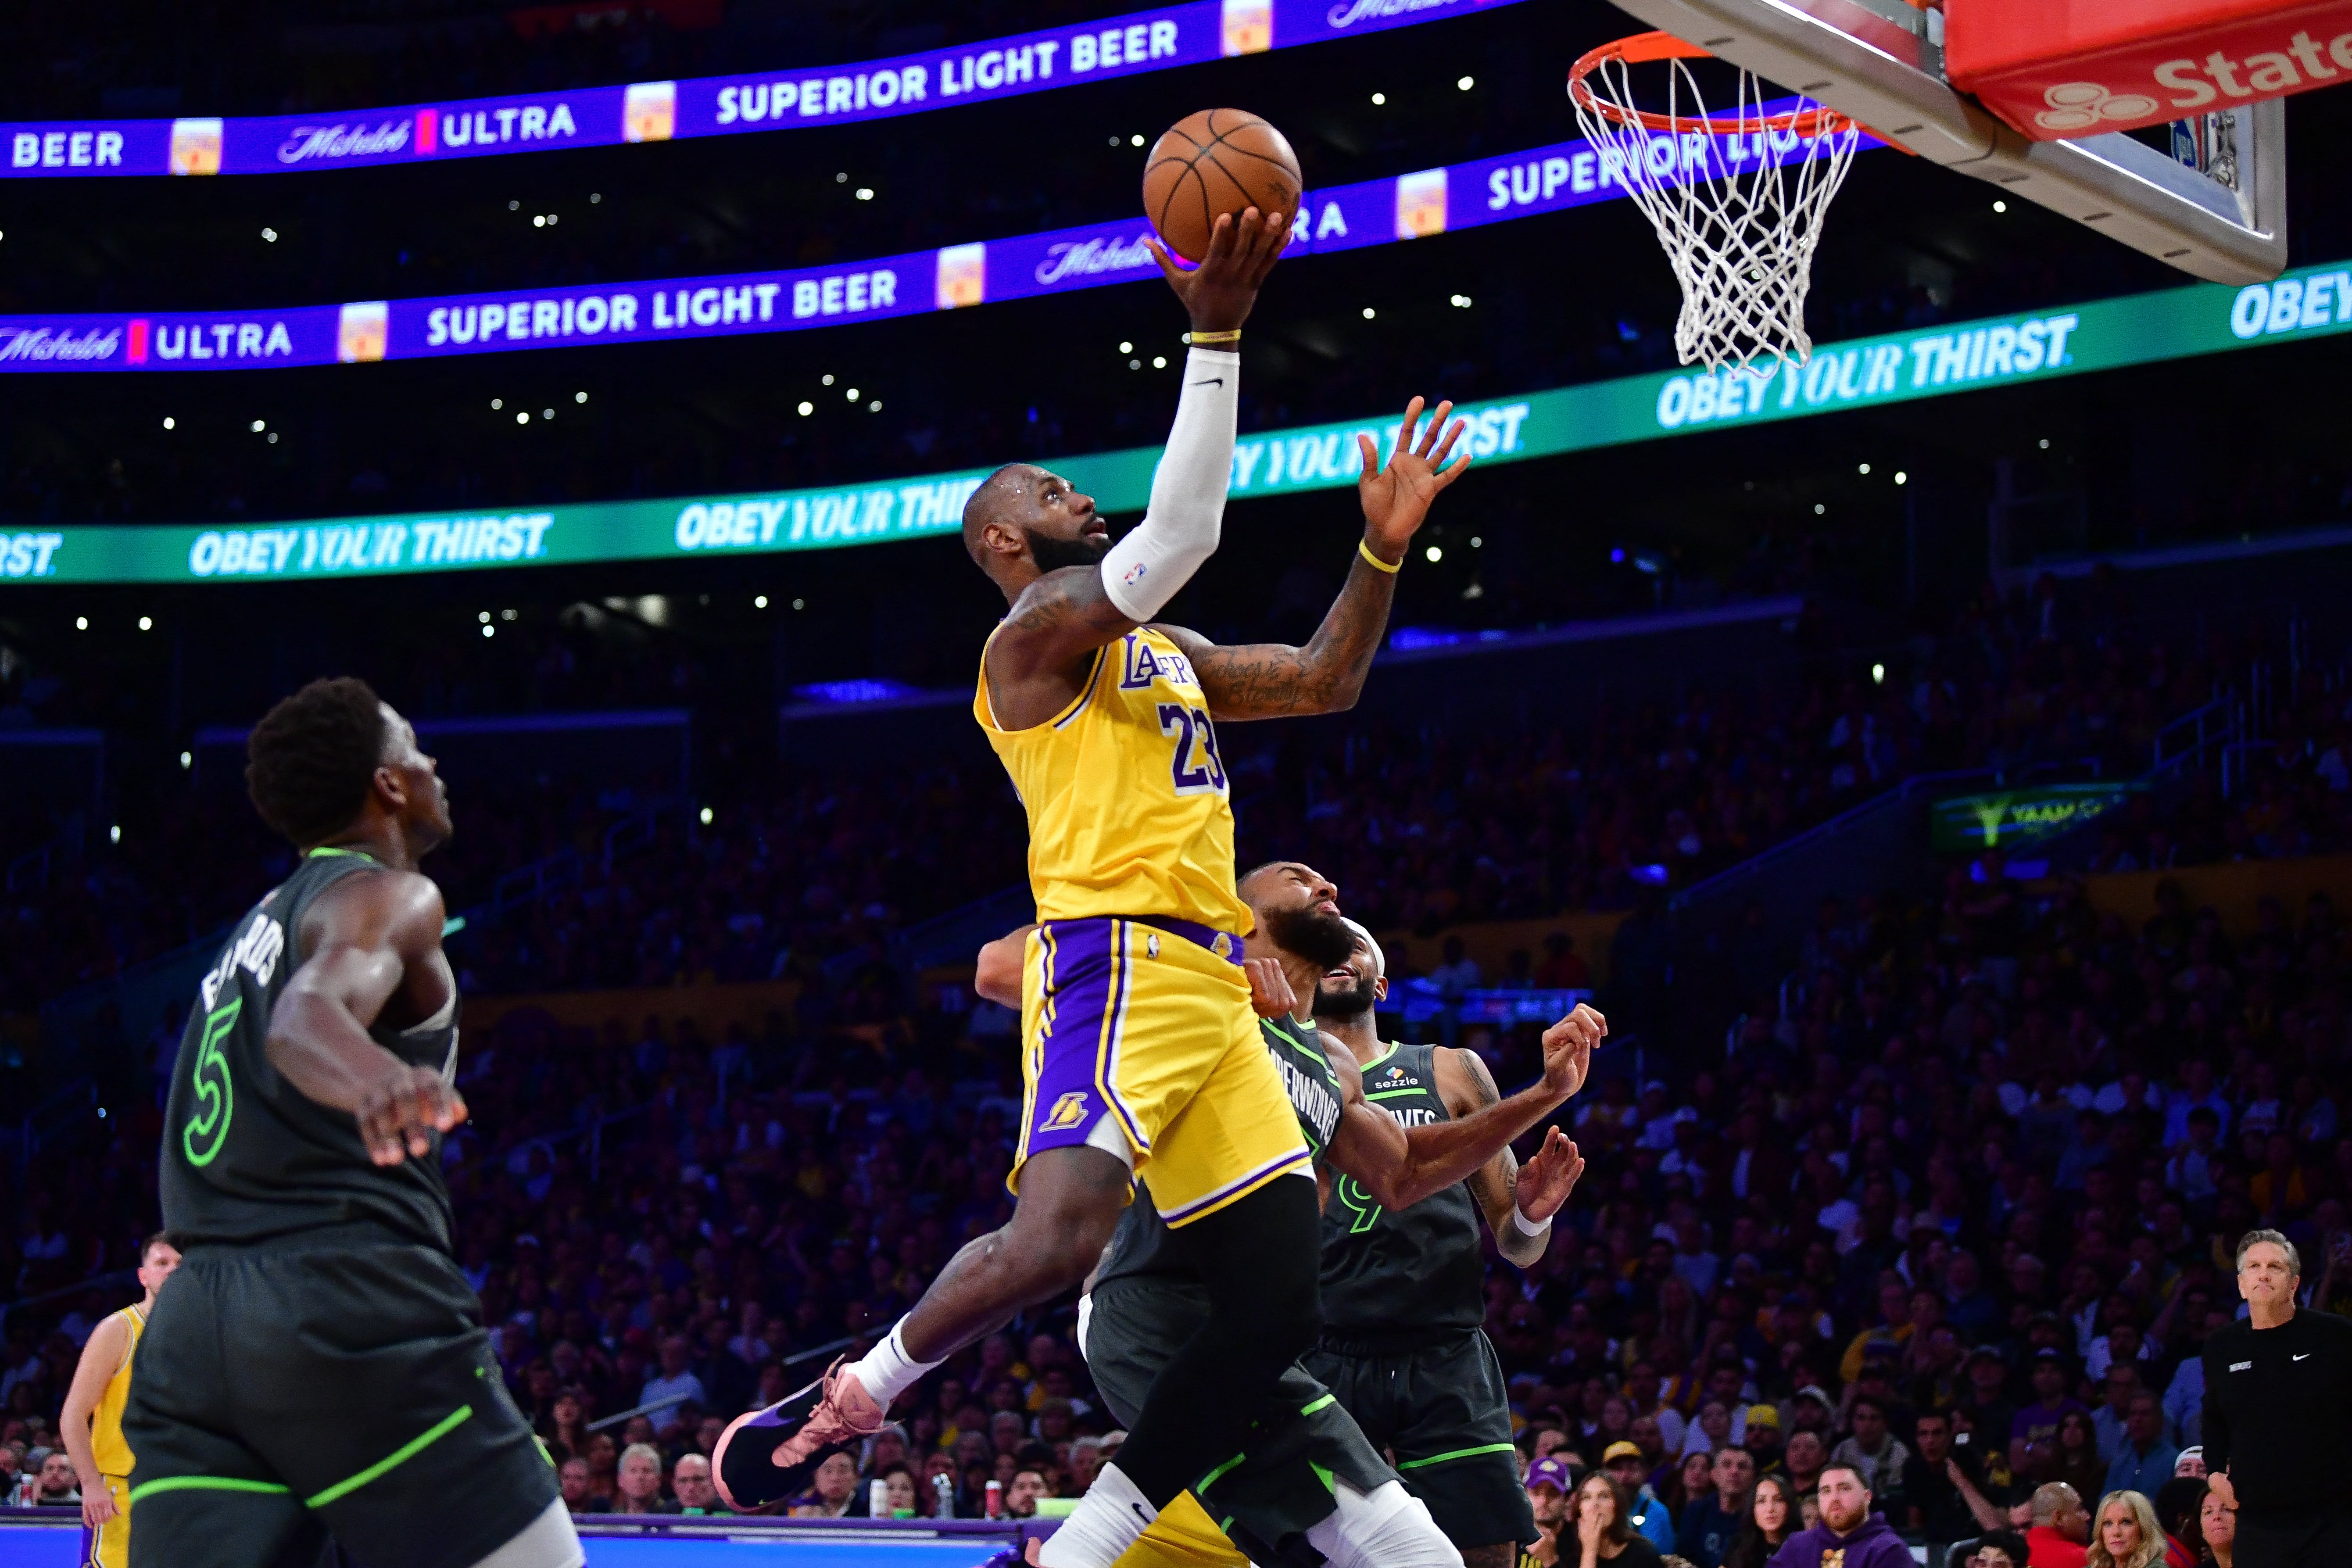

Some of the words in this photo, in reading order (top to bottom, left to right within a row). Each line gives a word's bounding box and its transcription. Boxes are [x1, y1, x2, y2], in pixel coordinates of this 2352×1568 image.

[716, 65, 928, 124] SUPERIOR
[939, 40, 1060, 96] LIGHT
[1070, 20, 1178, 73] BEER
[12, 131, 123, 168] BEER
[443, 103, 577, 147] ULTRA
[1488, 132, 1710, 210] SUPERIOR
[156, 322, 292, 359] ULTRA
[427, 294, 638, 346] SUPERIOR
[652, 283, 781, 329] LIGHT
[792, 269, 897, 319] BEER
[1658, 364, 1775, 427] OBEY
[1780, 343, 1903, 407] YOUR
[191, 530, 298, 575] OBEY
[302, 524, 407, 569] YOUR
[676, 500, 788, 548] OBEY
[790, 490, 894, 541] YOUR
[1156, 702, 1230, 796] 23
[183, 996, 243, 1167] 5
[1375, 1077, 1418, 1089] sezzle
